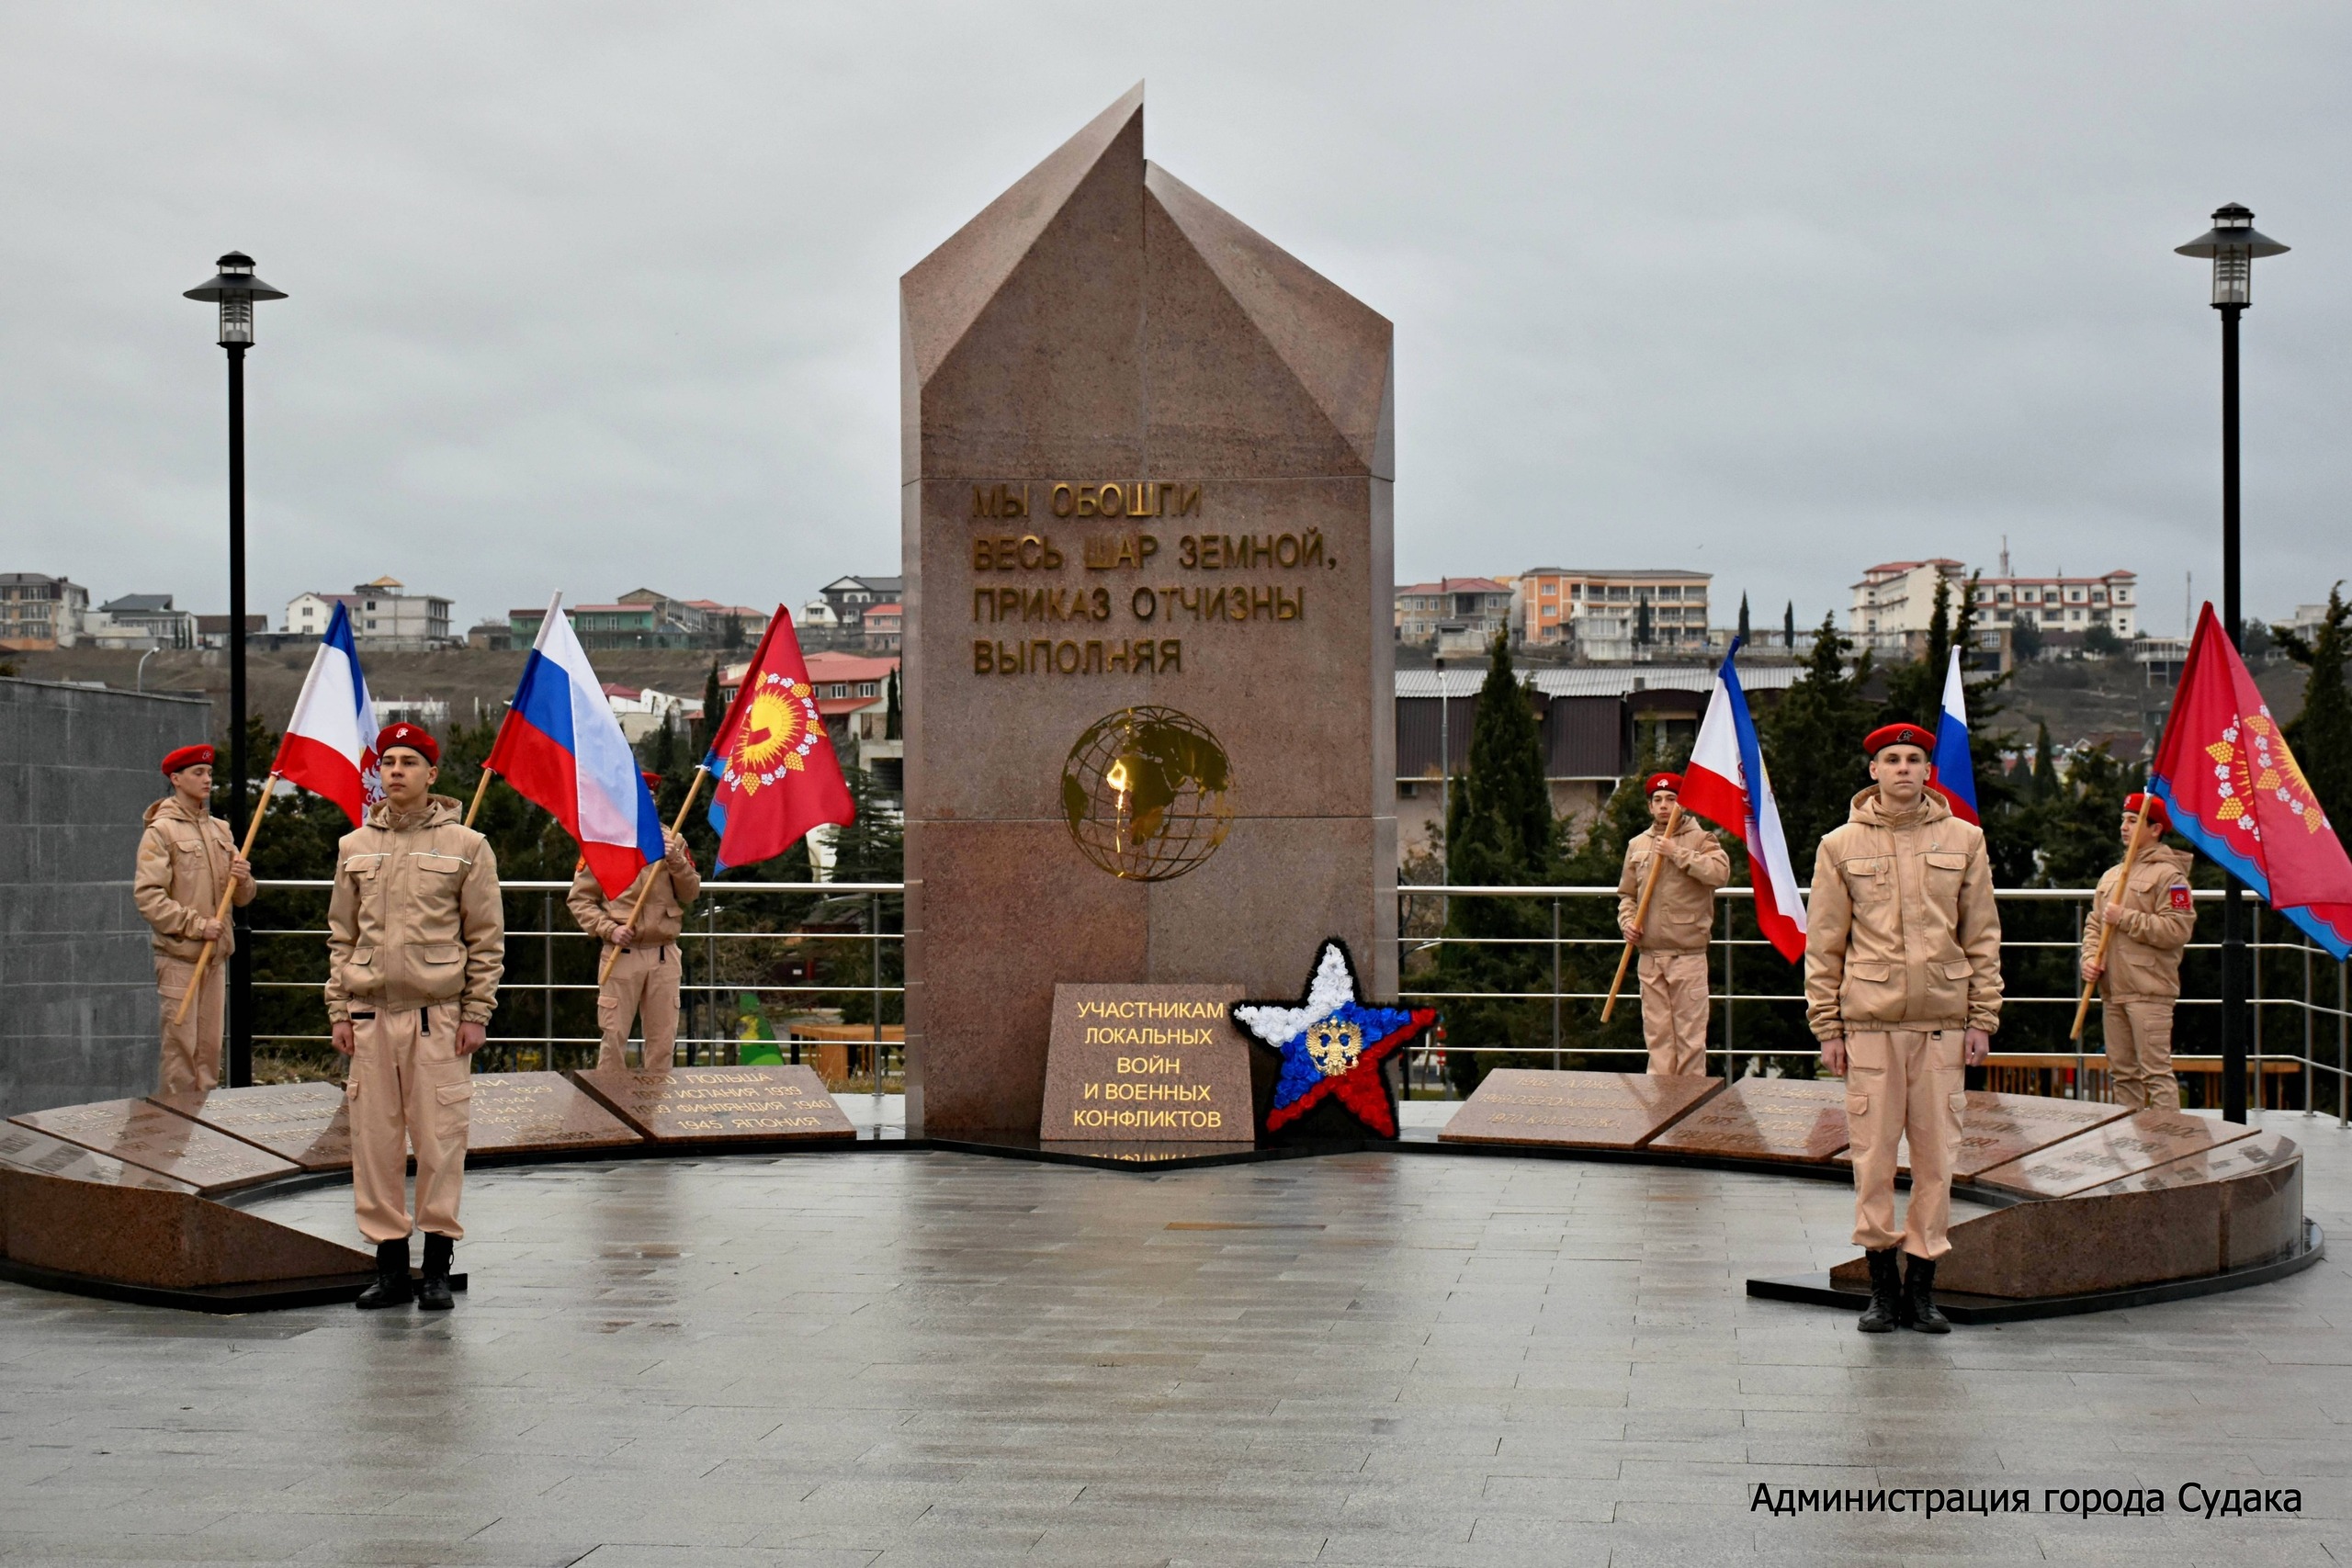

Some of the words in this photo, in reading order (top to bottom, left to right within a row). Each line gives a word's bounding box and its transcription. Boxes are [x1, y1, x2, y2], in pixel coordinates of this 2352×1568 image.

[972, 483, 1029, 518] МЫ
[1050, 482, 1202, 518] ОБОШЛИ
[973, 534, 1064, 570] ВЕСЬ
[1084, 534, 1158, 570] ШАР
[1179, 525, 1338, 571] ЗЕМНОЙ,
[974, 586, 1111, 622] ПРИКАЗ
[1132, 586, 1304, 621] ОТЧИЗНЫ
[974, 638, 1182, 675] ВЫПОЛНЯЯ
[1077, 1001, 1225, 1020] УЧАСТНИКАМ
[1084, 1027, 1213, 1045] ЛОКАЛЬНЫХ
[1117, 1054, 1181, 1075] ВОЙН
[633, 1076, 677, 1086] 1920
[685, 1073, 774, 1085] ПОЛЬША
[1516, 1077, 1557, 1089] 1962
[674, 1088, 760, 1100] ИСПАНИЯ
[764, 1086, 802, 1097] 1939
[1084, 1084, 1098, 1100] И
[1105, 1084, 1211, 1100] ВОЕННЫХ
[476, 1106, 534, 1115] 1945
[677, 1101, 786, 1114] ФИНЛЯНДИЯ
[792, 1100, 832, 1111] 1940
[677, 1120, 723, 1131] 1945
[731, 1117, 822, 1129] ЯПОНИЯ
[1074, 1109, 1222, 1129] КОНФЛИКТОВ
[1525, 1114, 1623, 1129] КАМБОДЖА
